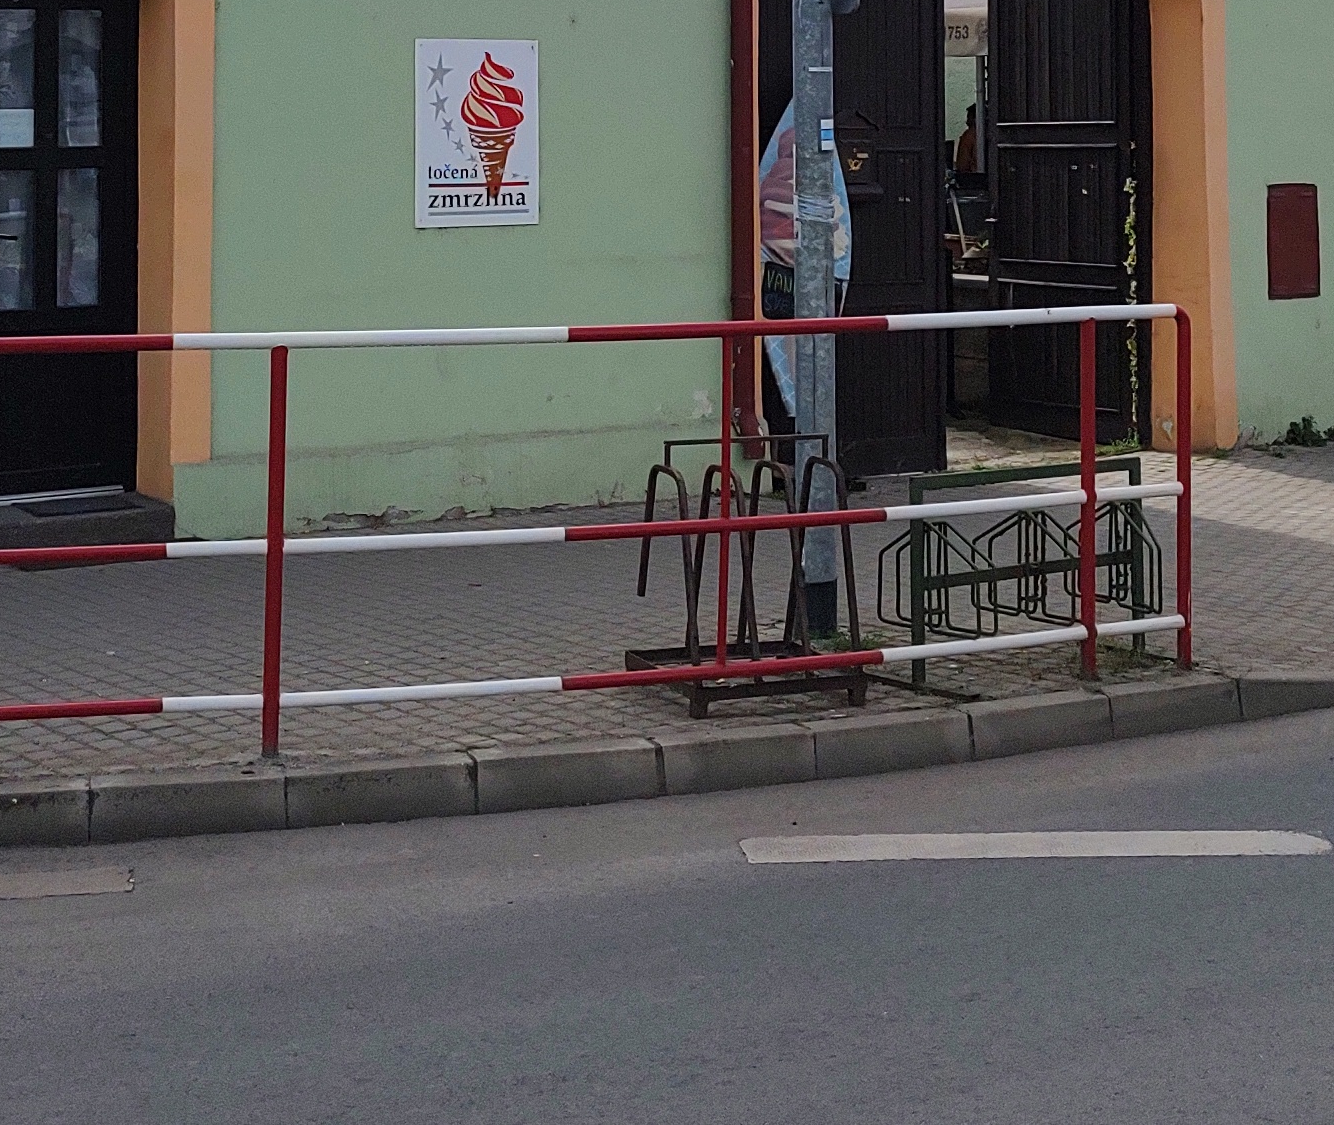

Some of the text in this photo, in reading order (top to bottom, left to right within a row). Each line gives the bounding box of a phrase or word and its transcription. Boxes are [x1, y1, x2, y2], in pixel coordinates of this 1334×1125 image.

[948, 25, 969, 40] 753
[428, 186, 527, 208] zmrzlina
[767, 269, 793, 293] VAN
